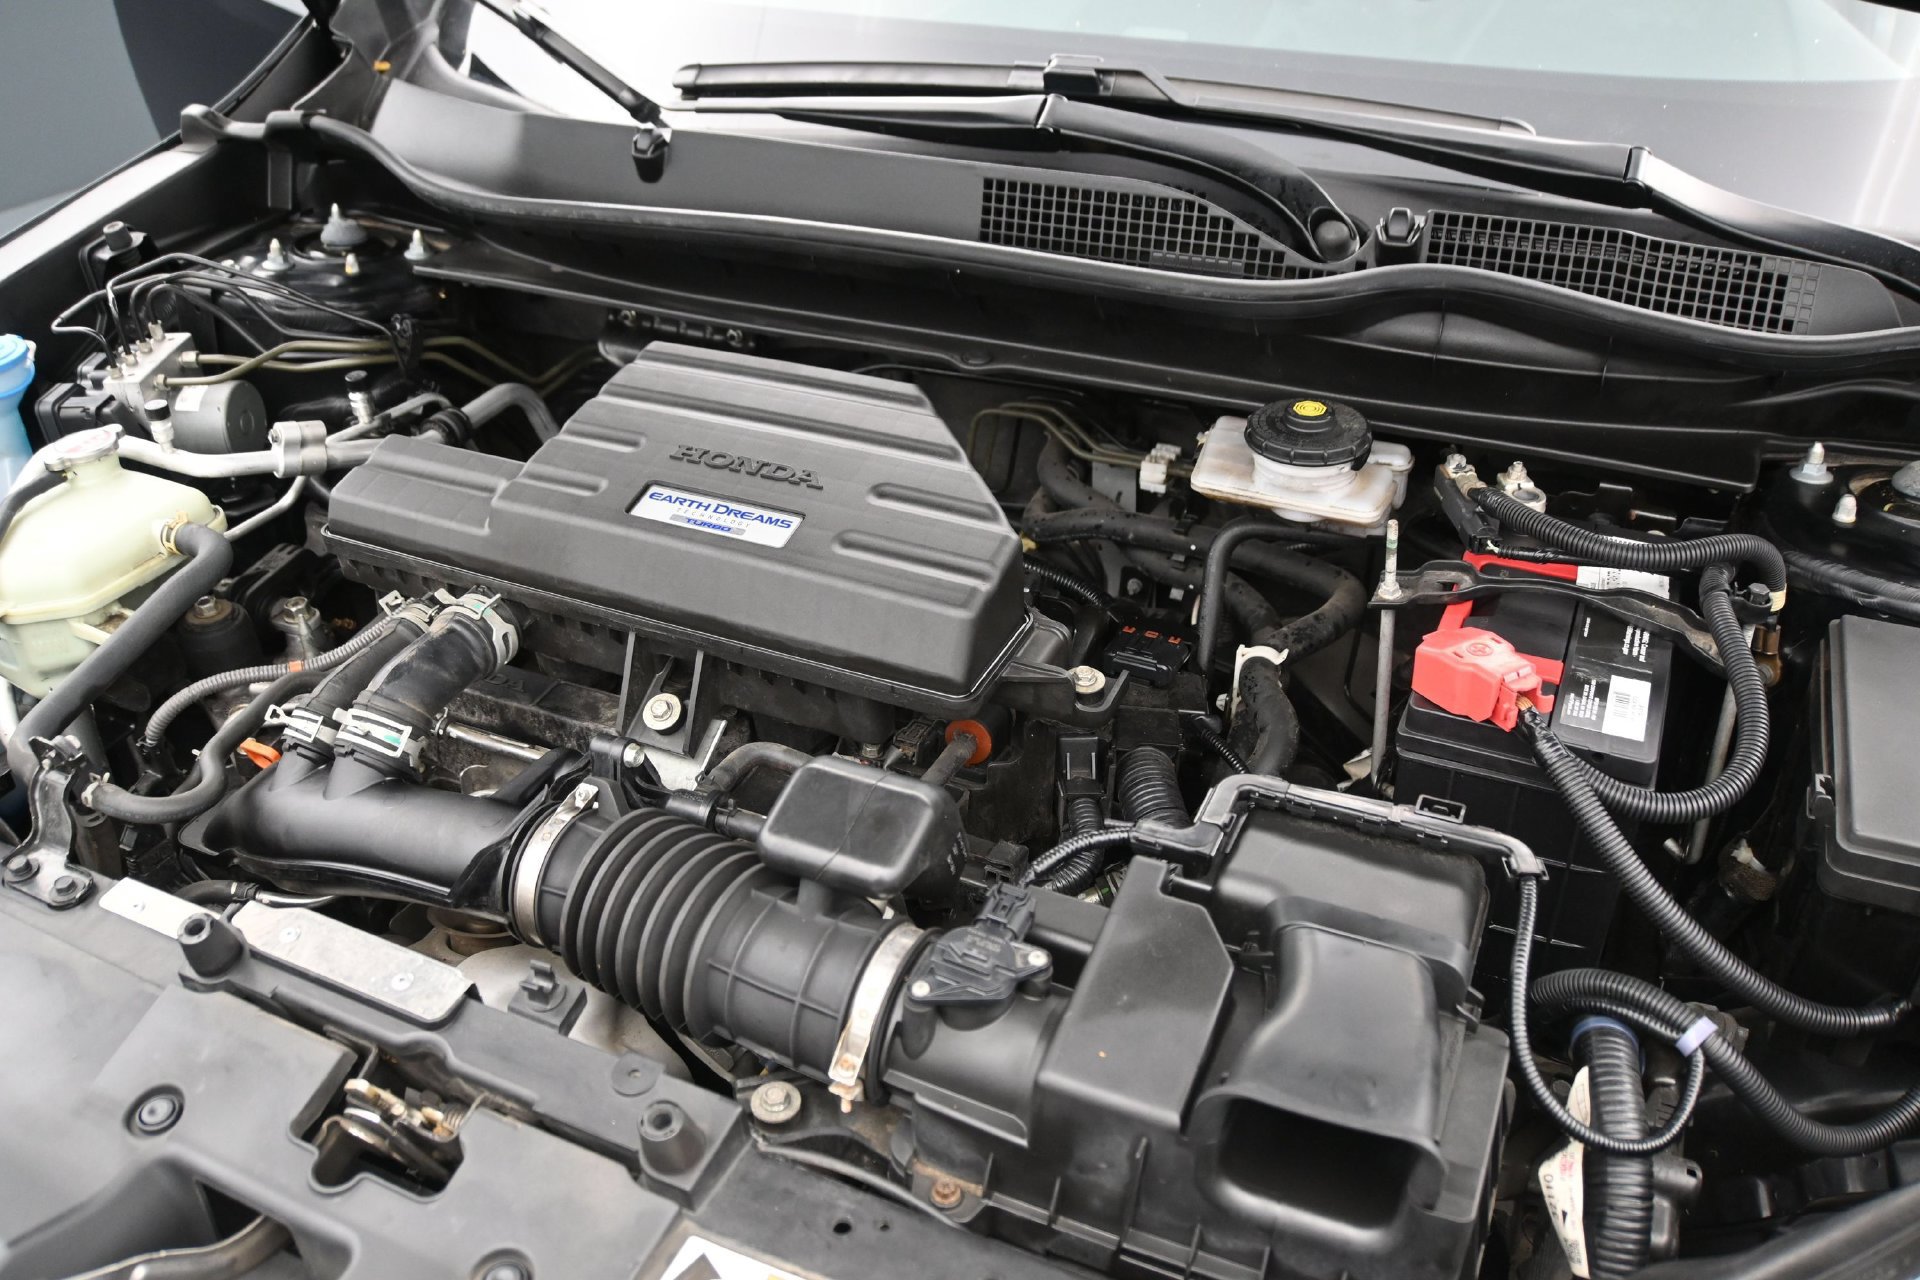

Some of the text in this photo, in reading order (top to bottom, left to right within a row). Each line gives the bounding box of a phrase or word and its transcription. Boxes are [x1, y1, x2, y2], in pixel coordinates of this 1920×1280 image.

[669, 444, 824, 490] HONDA
[649, 492, 793, 529] EARTH DREAMS
[676, 507, 751, 528] TECHNOLOGY
[686, 518, 732, 532] TURBO
